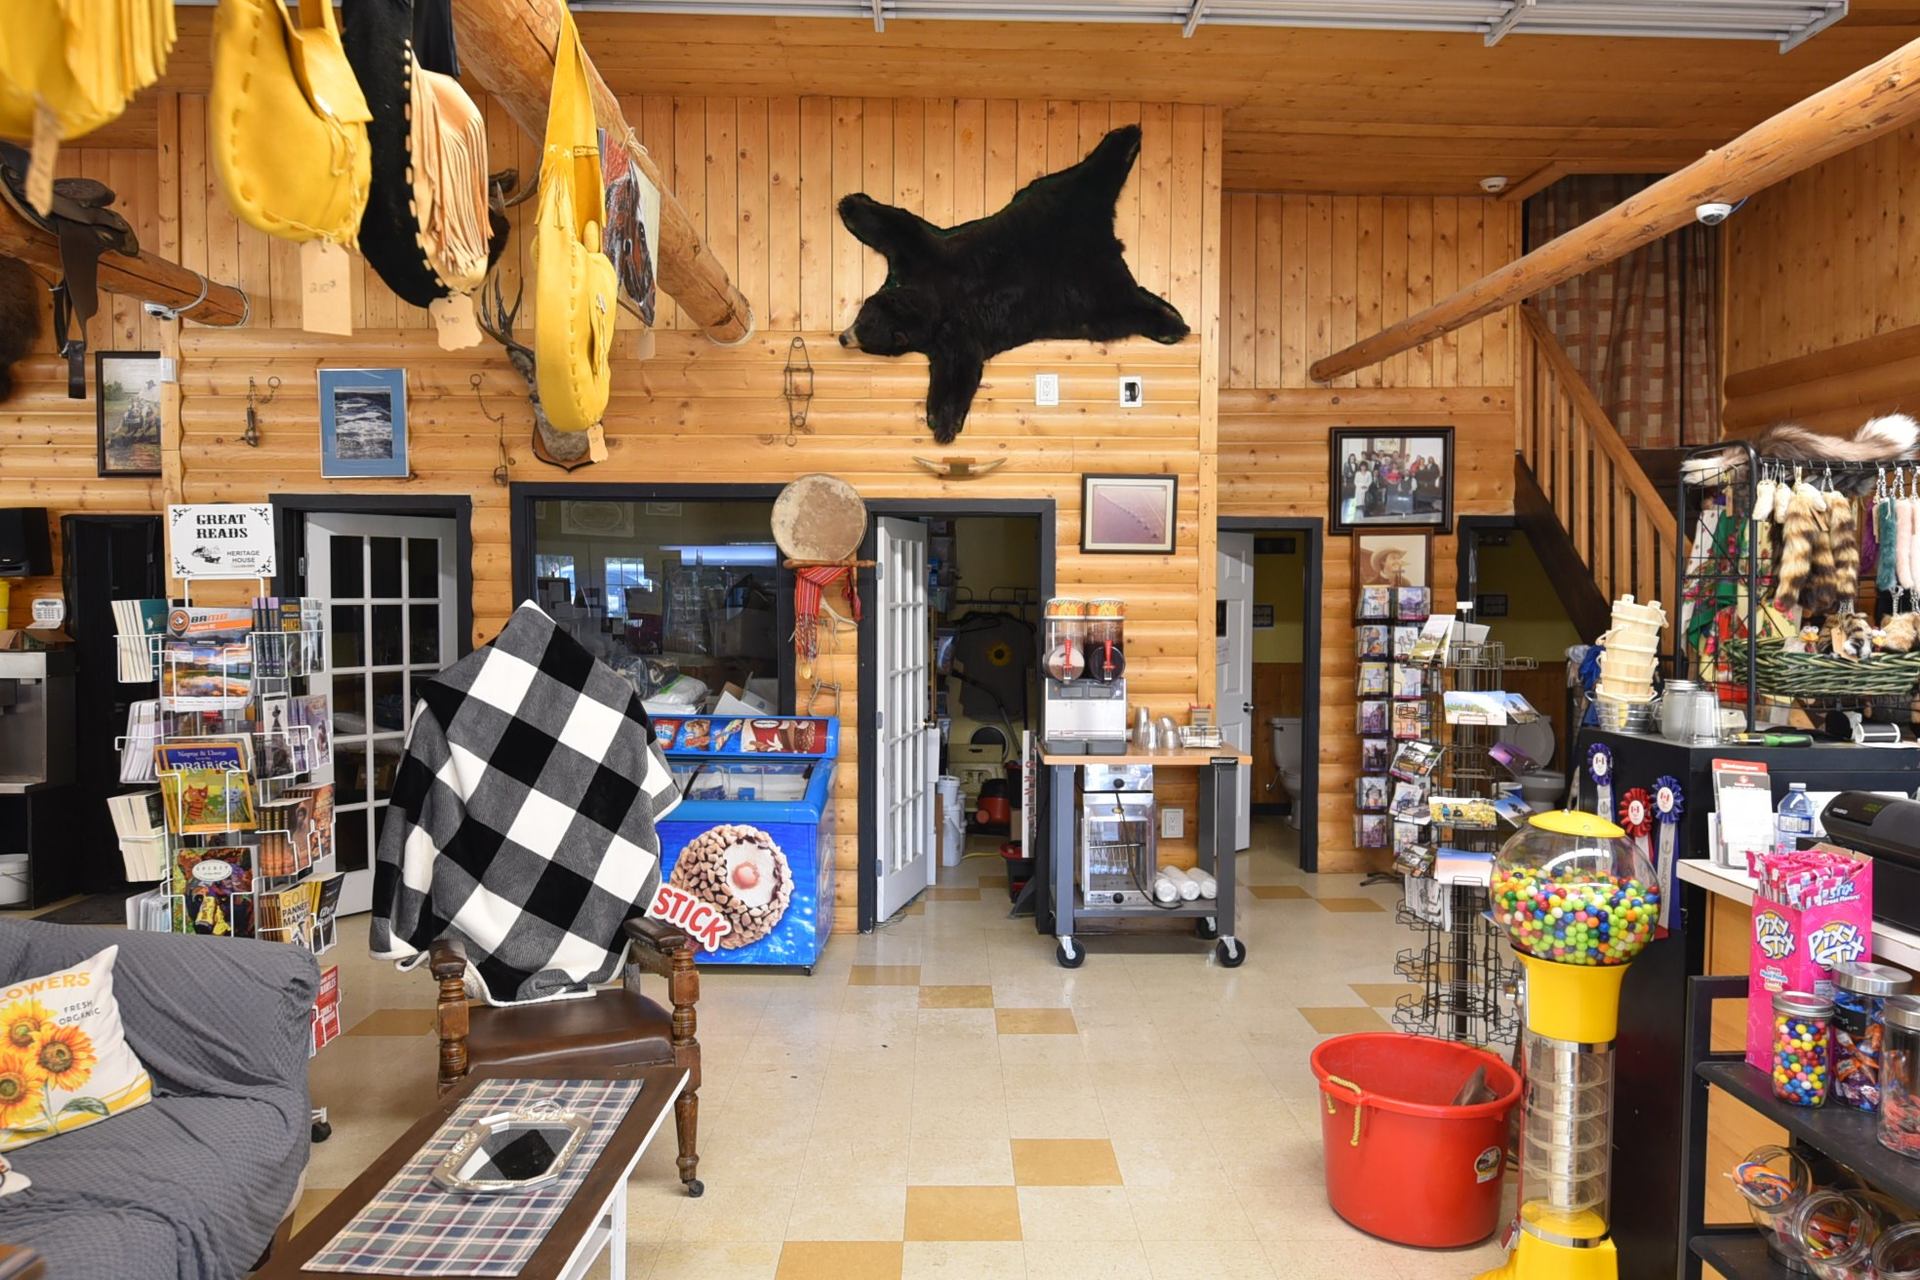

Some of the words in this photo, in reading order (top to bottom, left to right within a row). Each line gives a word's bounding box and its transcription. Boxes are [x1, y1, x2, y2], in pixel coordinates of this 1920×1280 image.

[196, 514, 246, 525] GREAT
[196, 528, 248, 539] READS
[653, 887, 727, 948] STICK
[1755, 914, 1789, 943] PIXY
[1760, 934, 1796, 958] STIX
[1807, 925, 1857, 961] PIXY
[1815, 935, 1865, 971] STIX
[1, 972, 91, 1003] OWERS
[58, 1007, 101, 1025] ORGANIC
[64, 1000, 93, 1013] FRESH
